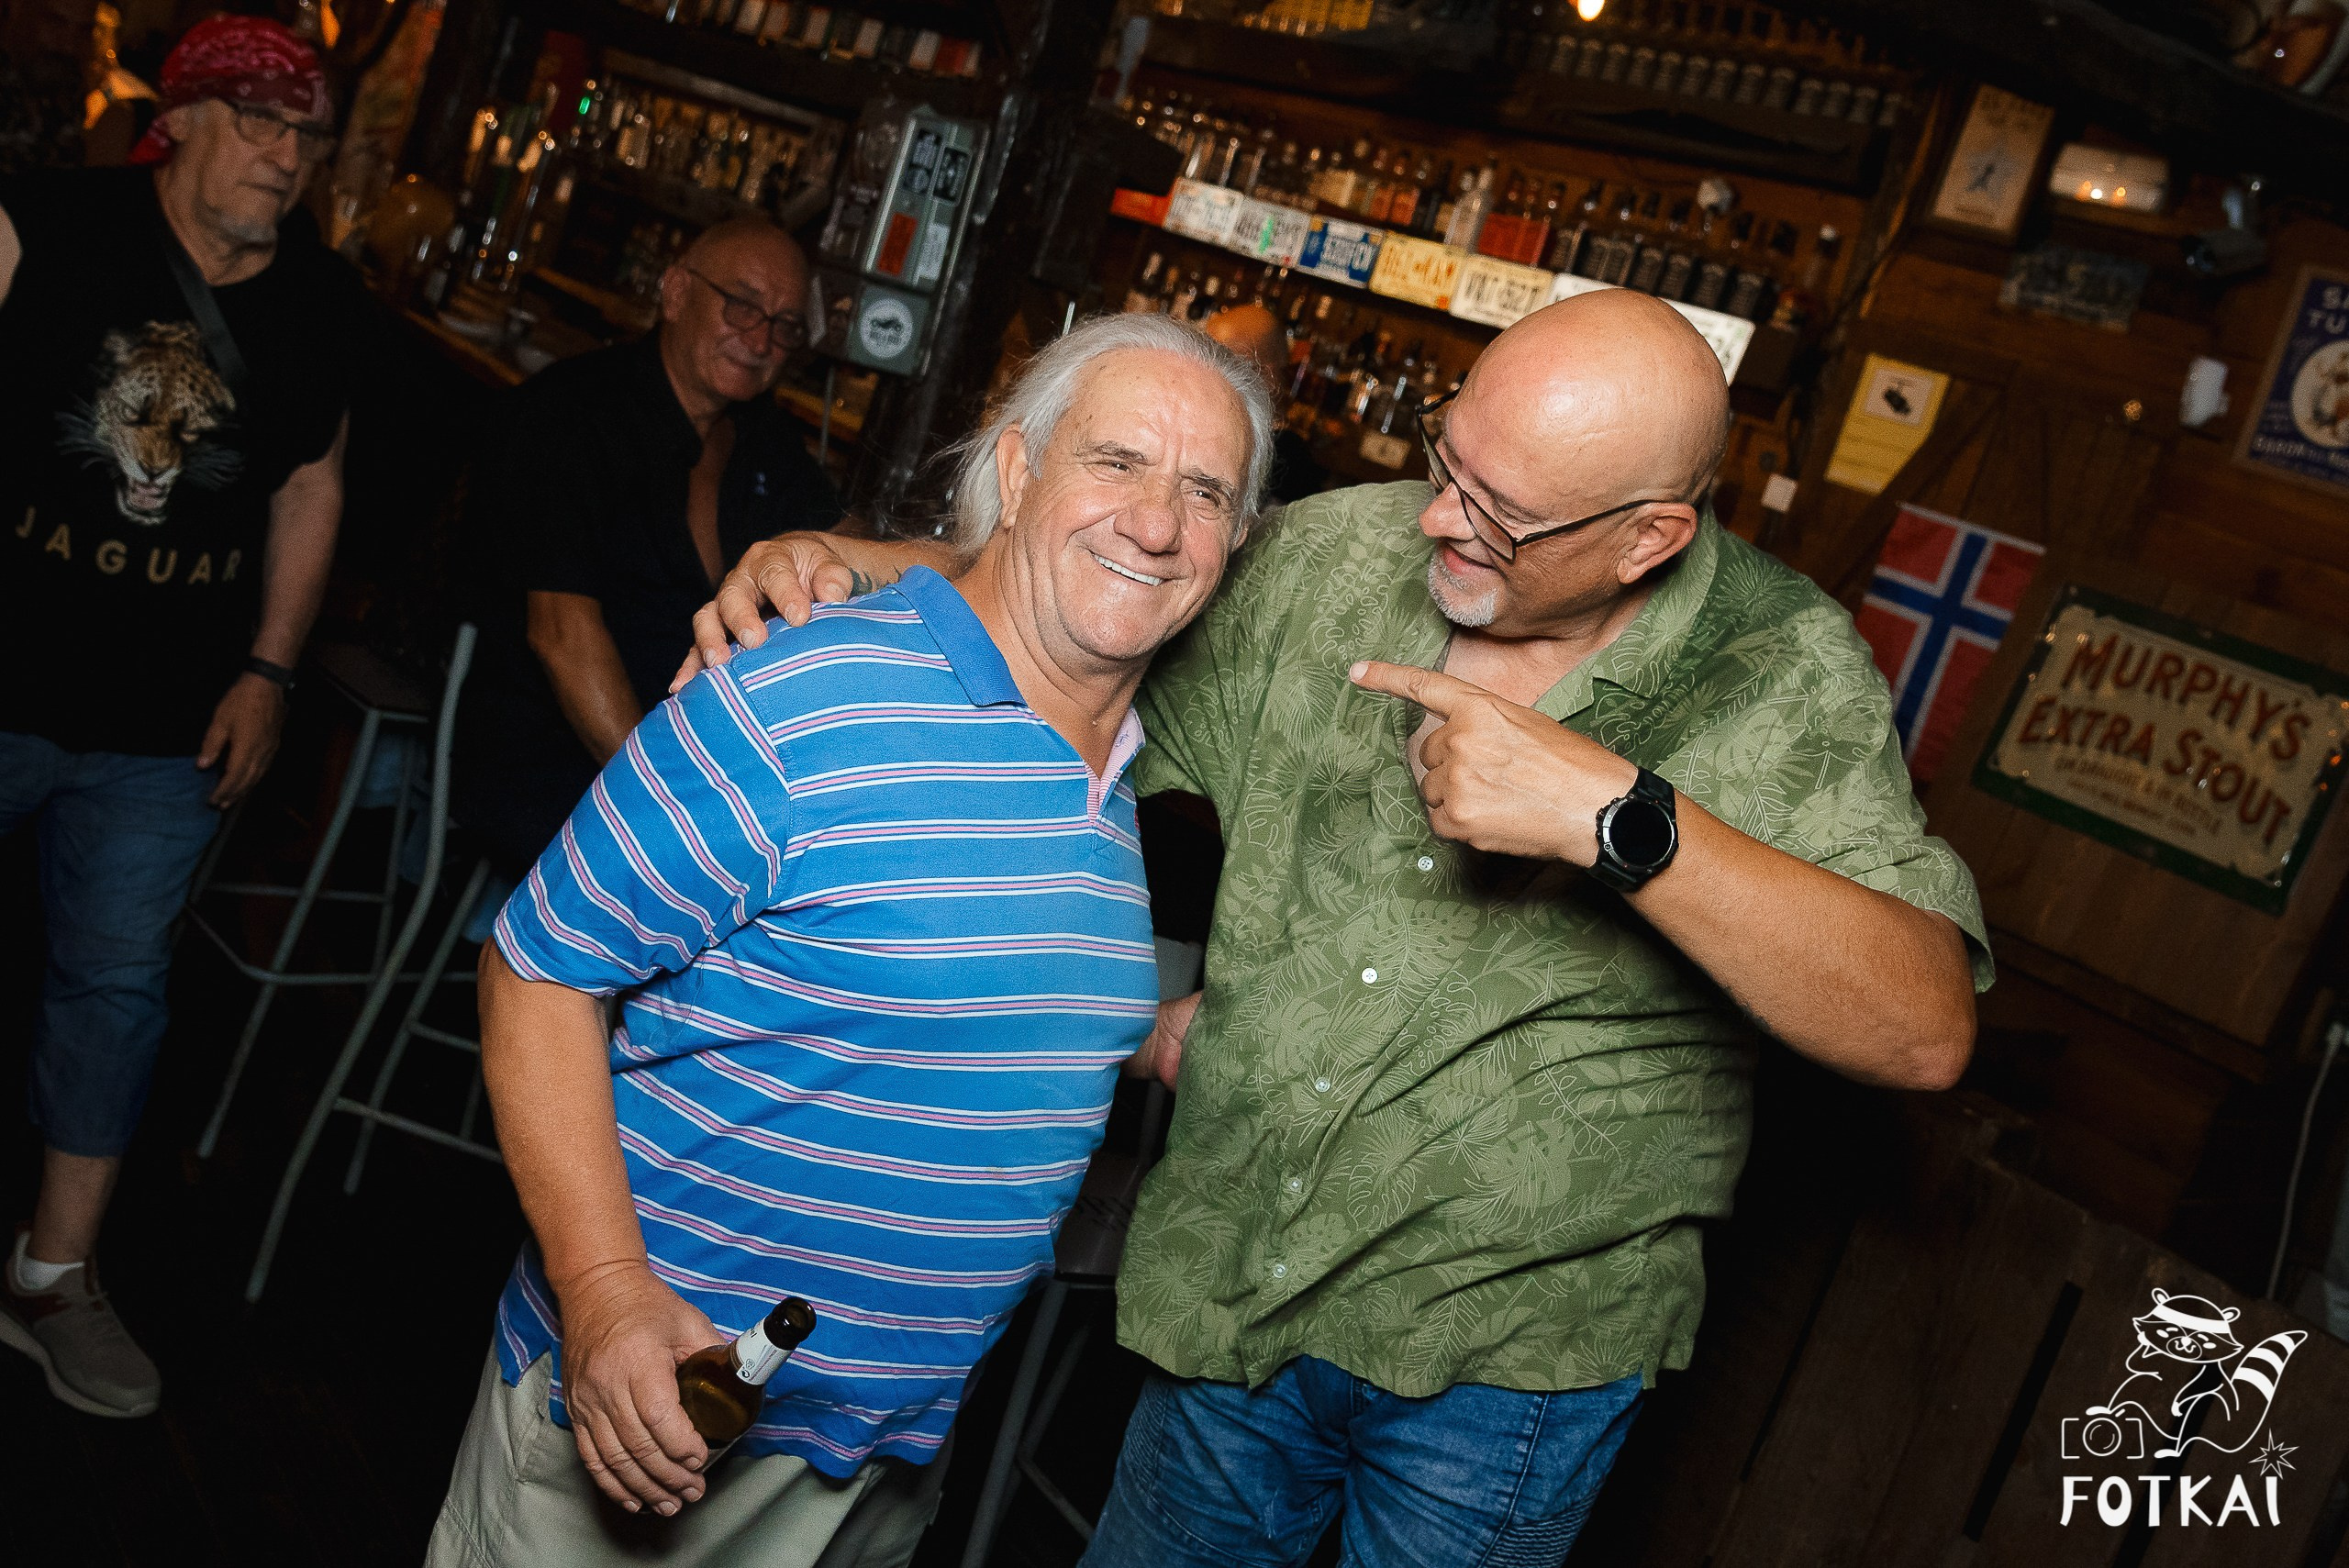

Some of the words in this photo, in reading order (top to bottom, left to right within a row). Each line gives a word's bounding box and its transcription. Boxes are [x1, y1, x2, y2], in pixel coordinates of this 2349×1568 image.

[16, 505, 242, 585] JAGUAR
[2061, 633, 2314, 762] MURPHY'S
[2020, 695, 2156, 767] EXTRA
[2162, 728, 2294, 847] STOUT
